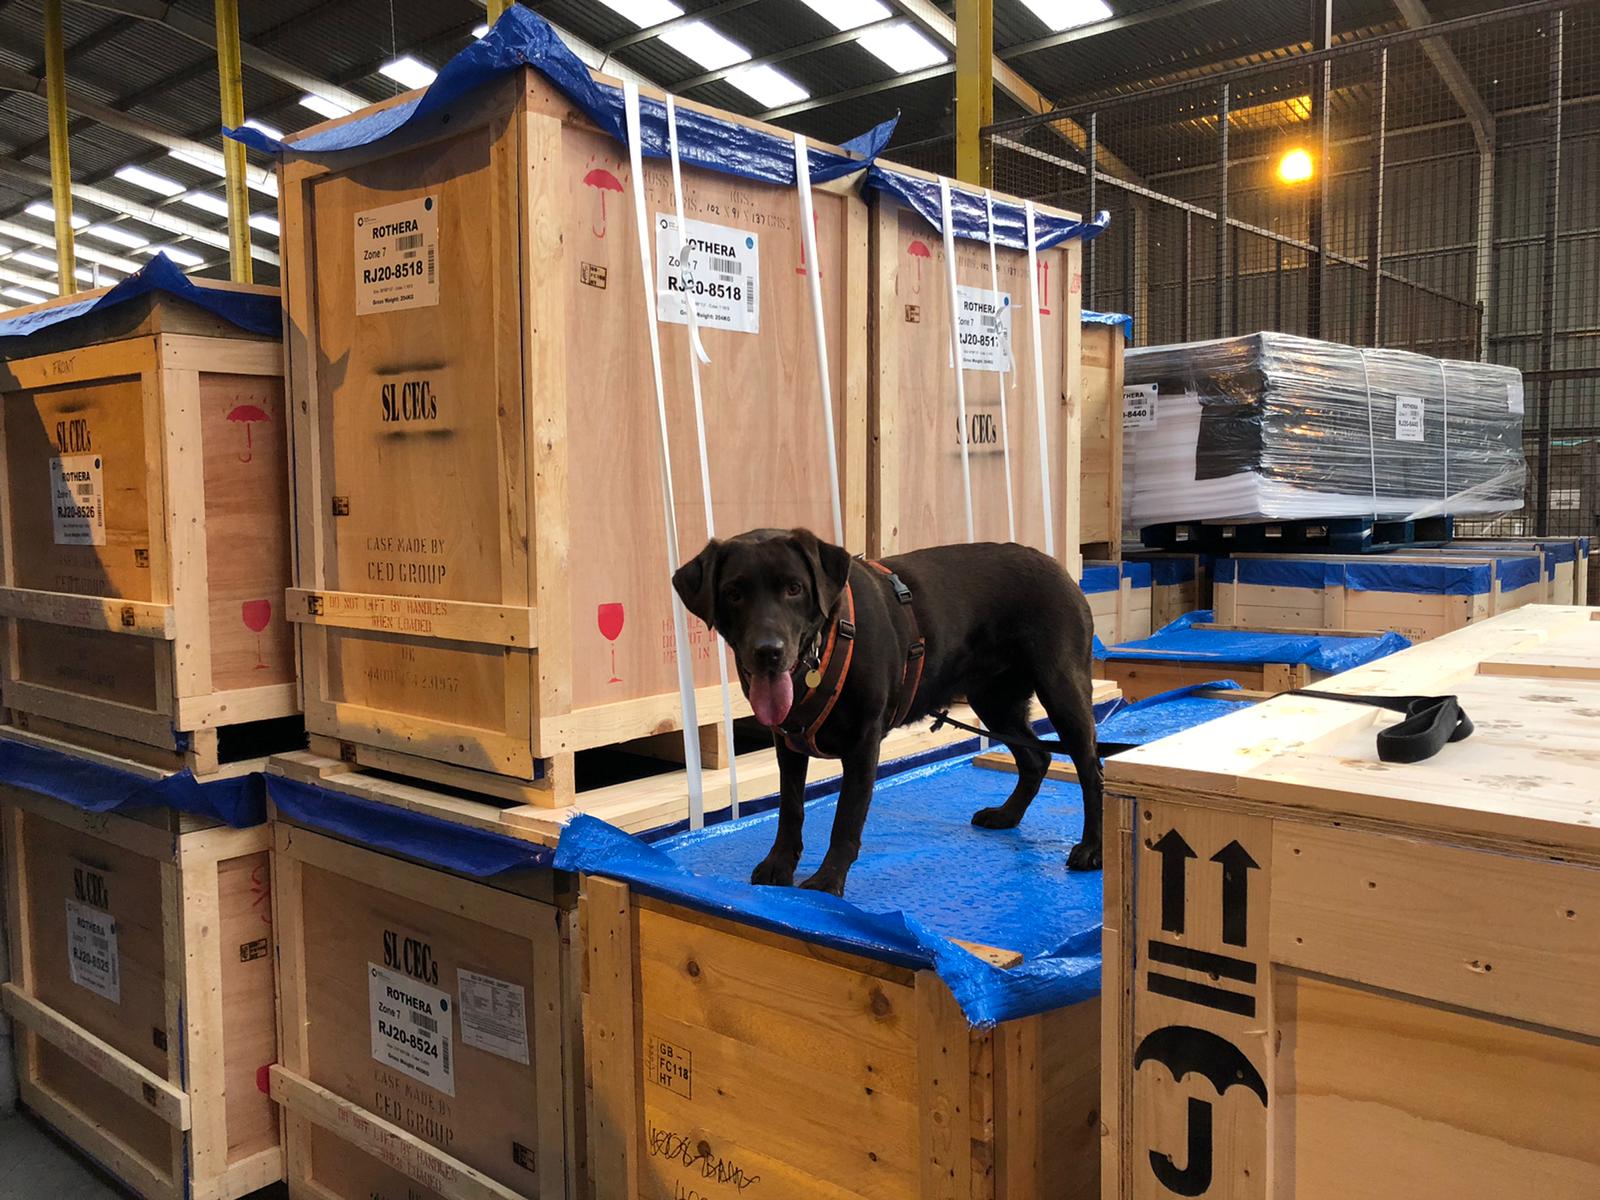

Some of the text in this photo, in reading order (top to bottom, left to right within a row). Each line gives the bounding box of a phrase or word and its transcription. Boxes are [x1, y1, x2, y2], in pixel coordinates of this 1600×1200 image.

[372, 219, 418, 239] ROTHERA
[364, 247, 387, 260] Zone 7
[686, 238, 736, 258] OTHERA
[363, 260, 423, 284] RJ20-8518
[693, 261, 698, 270] 7
[958, 317, 970, 326] one
[381, 380, 437, 422] SL CECs
[972, 414, 997, 444] CECs
[62, 472, 91, 482] ROTHERA
[57, 506, 95, 518] RJ20-8526
[367, 537, 445, 554] CASE MADE BY
[367, 562, 446, 584] CED GROUP
[344, 597, 359, 609] NOT
[407, 601, 448, 616] HANDLES
[77, 917, 105, 936] ROTHERA
[383, 929, 439, 985] SL CECs
[386, 986, 433, 1015] ROTHERA
[378, 1001, 401, 1020] Zone 7
[378, 1019, 438, 1058] RJ20-8524
[660, 1043, 673, 1058] GB
[660, 1059, 689, 1080] FC118
[660, 1072, 672, 1087] HT
[375, 1091, 454, 1147] CED GROUP
